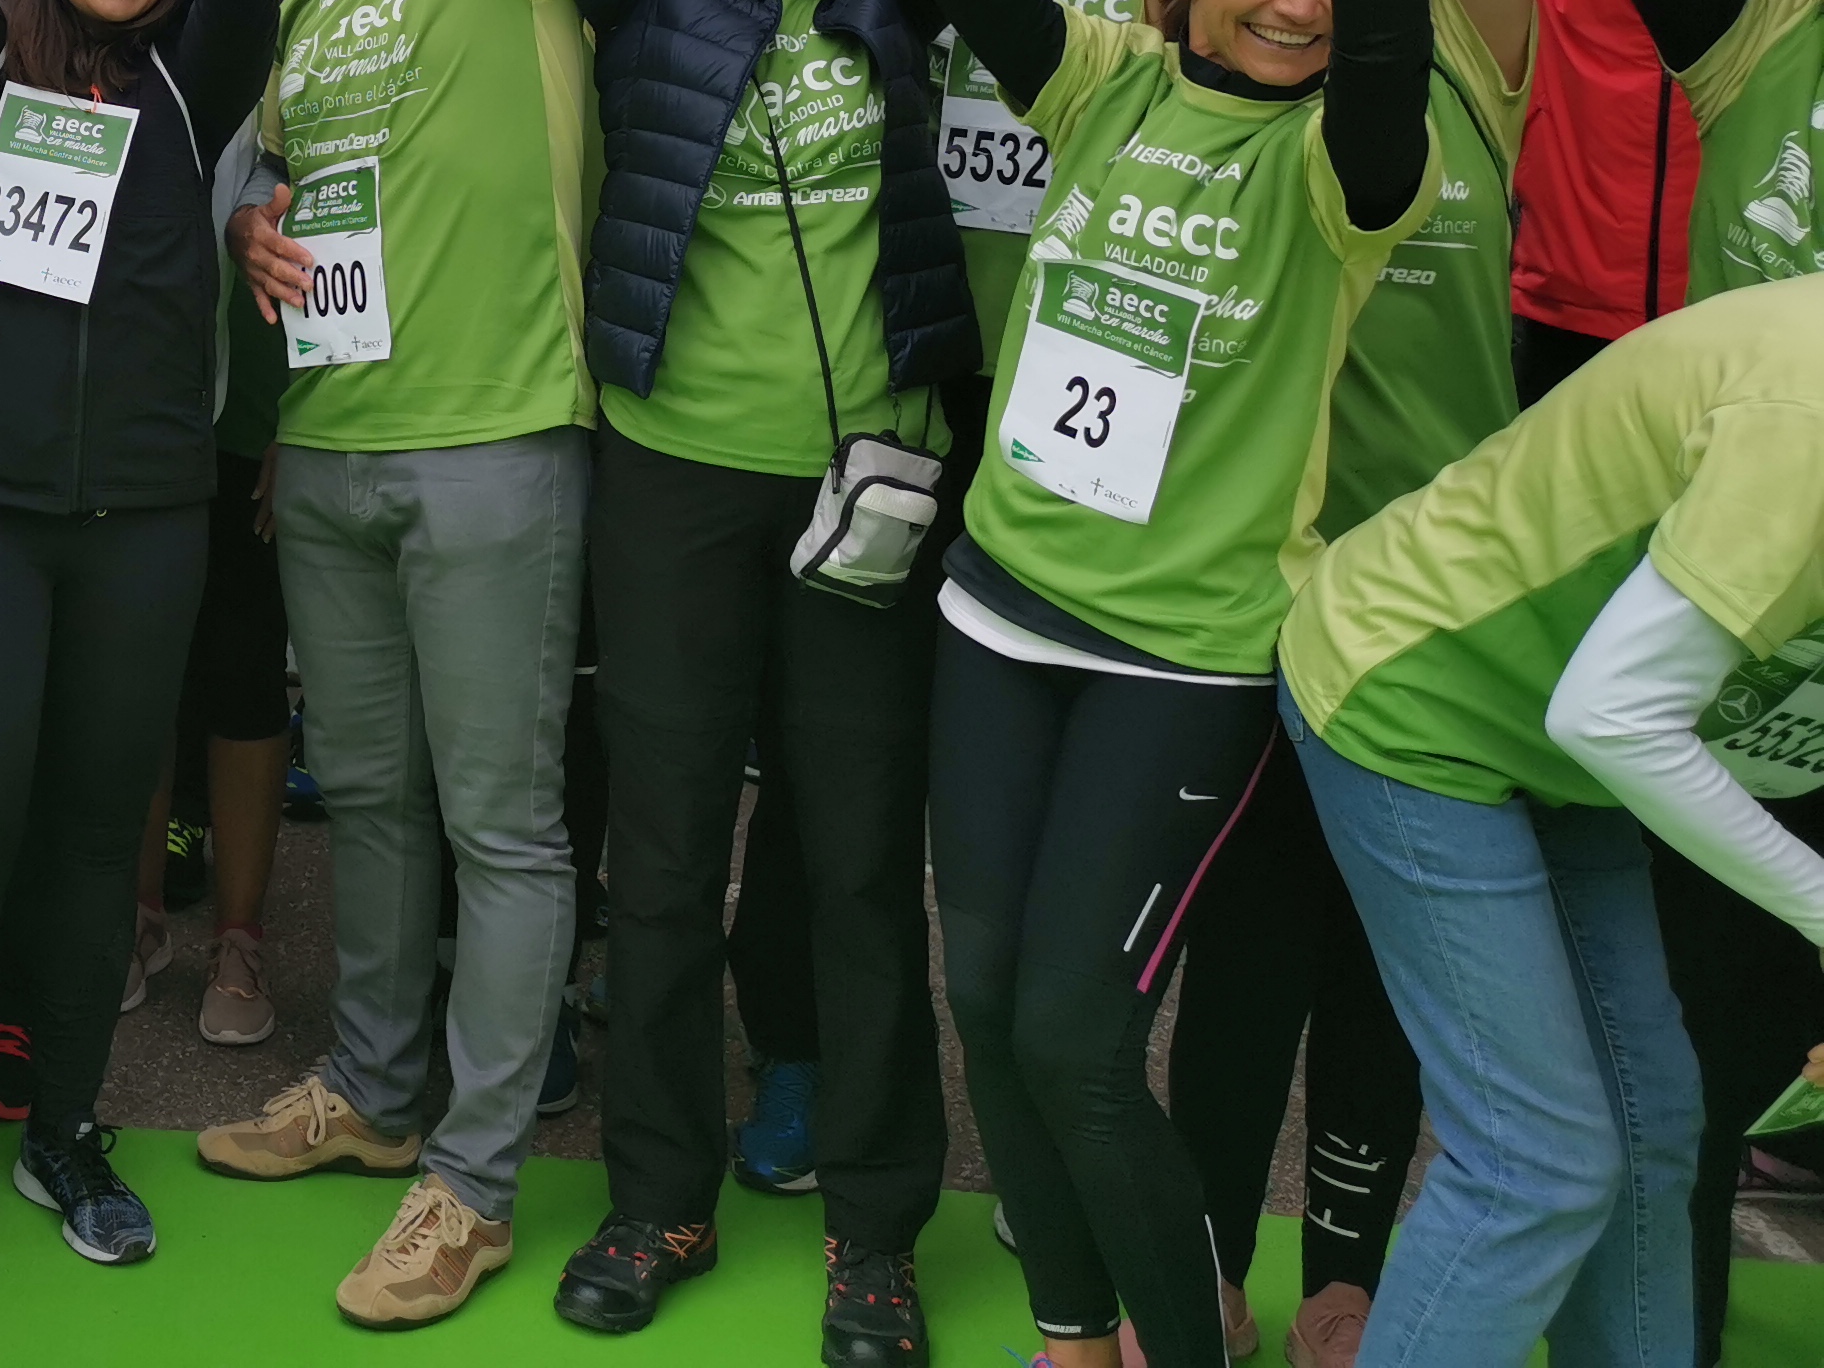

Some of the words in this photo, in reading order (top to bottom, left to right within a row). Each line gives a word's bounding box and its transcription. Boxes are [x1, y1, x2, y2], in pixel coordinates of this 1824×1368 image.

[366, 90, 377, 102] el
[51, 115, 105, 138] aecc
[772, 94, 844, 137] LLADOLID
[22, 143, 48, 155] Marcha
[48, 149, 72, 160] Contra
[82, 156, 108, 167] Cáncer
[46, 136, 64, 146] en
[63, 139, 107, 155] marcha
[943, 127, 1049, 188] 5532
[765, 156, 823, 180] Cntra
[828, 147, 845, 165] el
[318, 180, 358, 200] aecc
[1108, 194, 1241, 261] aecc
[1104, 241, 1209, 283] VALLADOLID
[52, 274, 82, 288] aecc
[1104, 305, 1142, 324] VALLADOLID
[1105, 285, 1169, 323] aecc
[1057, 313, 1071, 325] VIII
[1072, 318, 1103, 337] Marcha
[1104, 331, 1132, 348] Contra
[1133, 343, 1143, 352] el
[1143, 345, 1174, 363] Cáncer
[1100, 314, 1122, 327] en
[1121, 321, 1172, 345] marcha
[1053, 375, 1117, 449] 23
[1104, 487, 1139, 509] aecc
